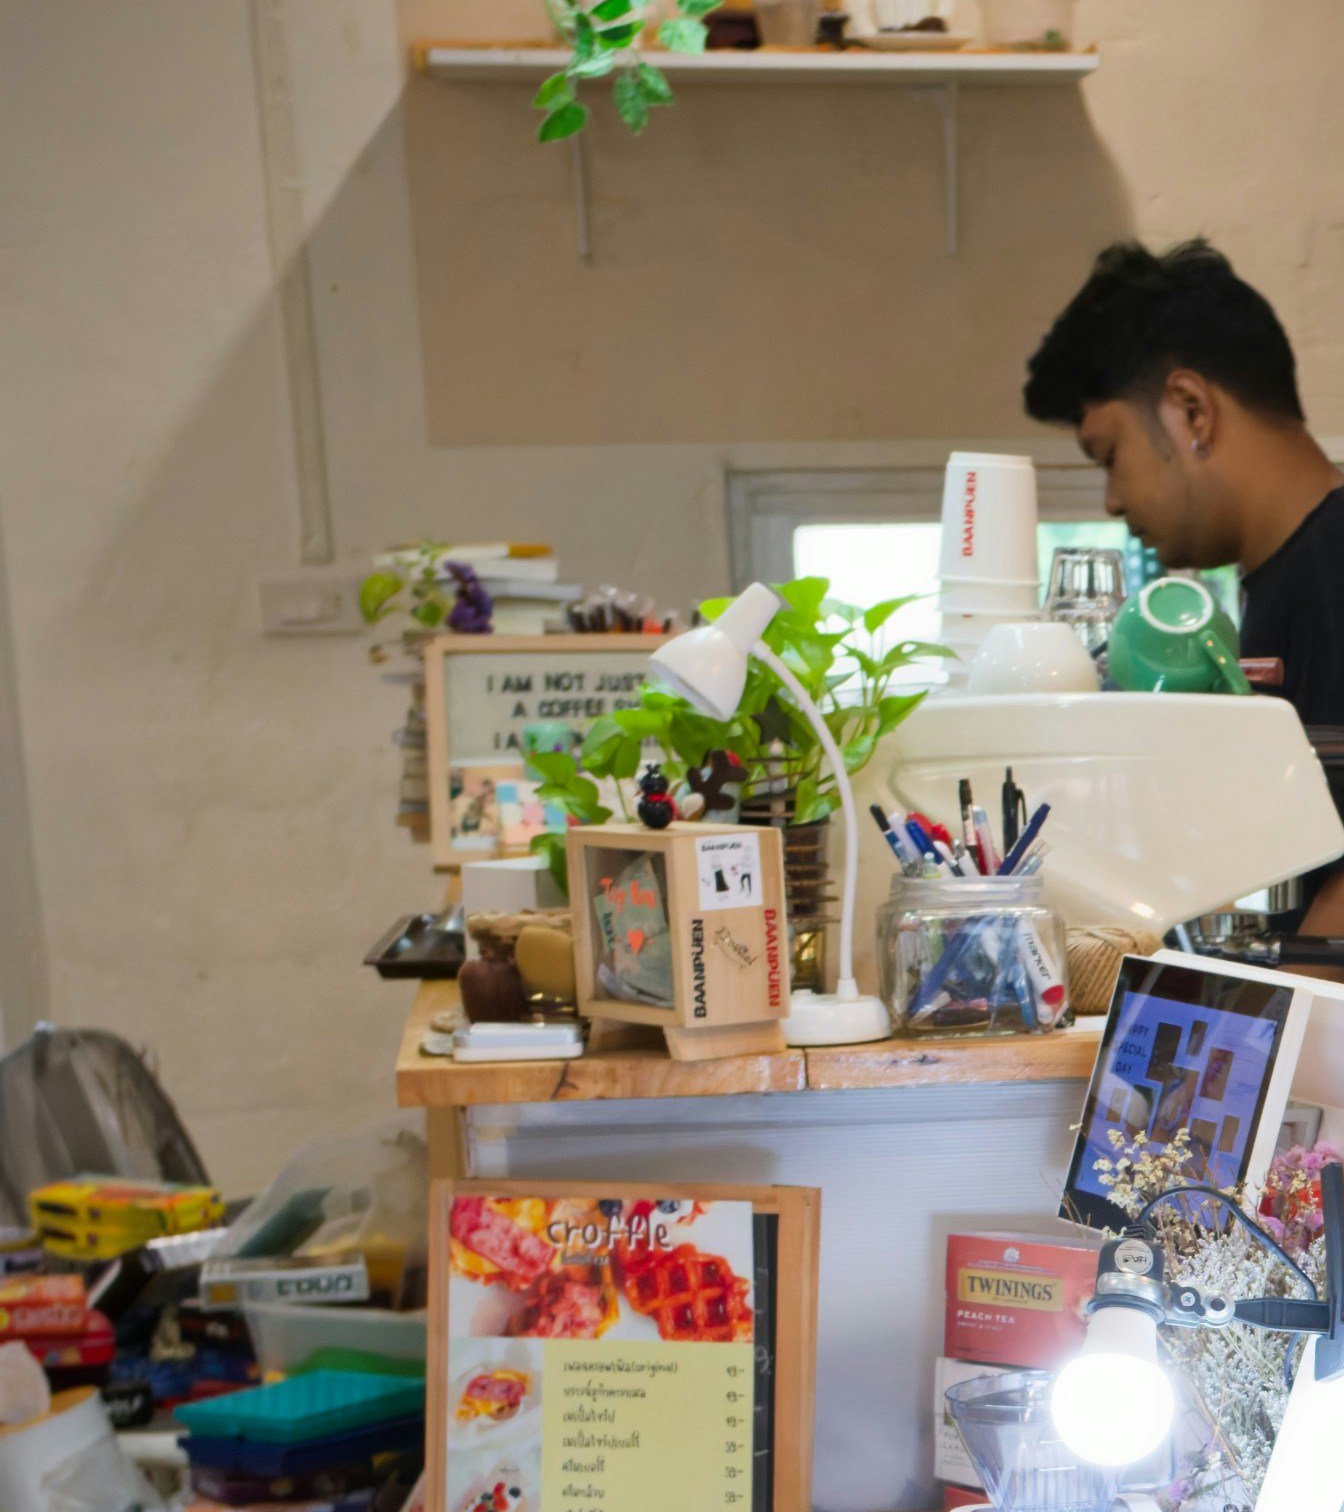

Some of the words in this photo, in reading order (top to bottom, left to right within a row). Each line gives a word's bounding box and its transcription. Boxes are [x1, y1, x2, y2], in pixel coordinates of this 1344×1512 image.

[502, 674, 532, 693] AM
[545, 672, 586, 692] NOT
[512, 700, 527, 718] A
[538, 697, 605, 718] COFFEE
[1022, 931, 1052, 981] marker
[547, 1214, 673, 1251] croffle
[967, 1275, 1053, 1303] TWININGS
[957, 1309, 992, 1322] PEACH
[995, 1313, 1016, 1325] TEA
